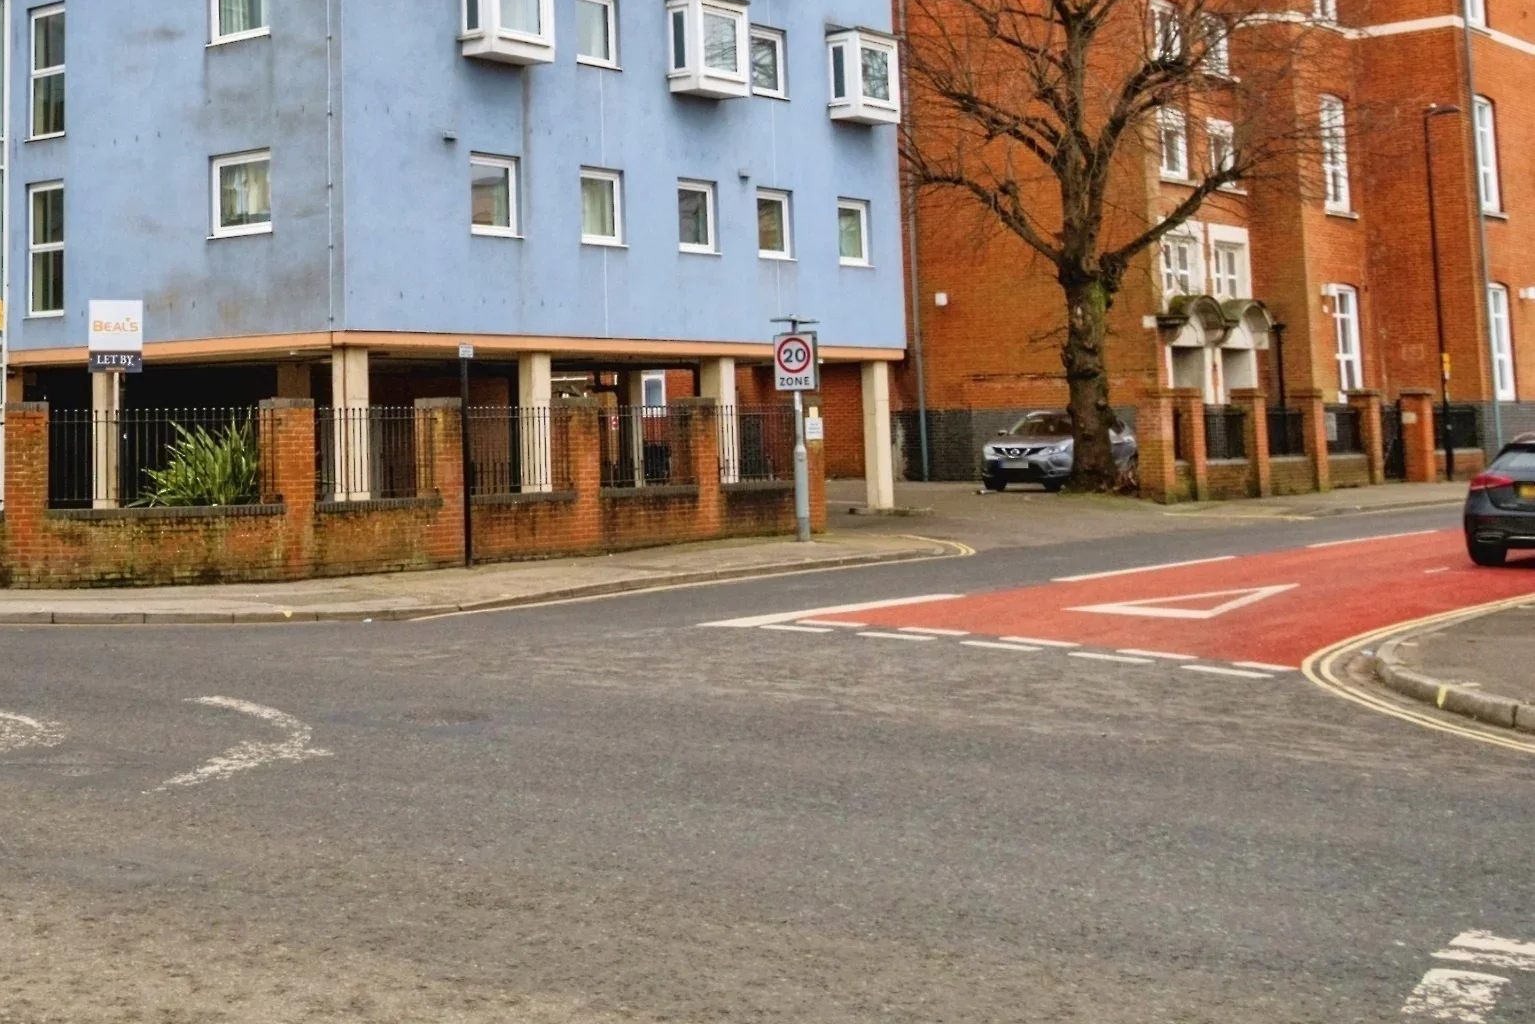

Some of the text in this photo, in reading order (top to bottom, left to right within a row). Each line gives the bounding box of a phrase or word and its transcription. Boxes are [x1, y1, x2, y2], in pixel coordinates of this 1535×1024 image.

[96, 355, 134, 365] LET BY
[783, 348, 806, 363] 20
[779, 376, 810, 386] ZONE
